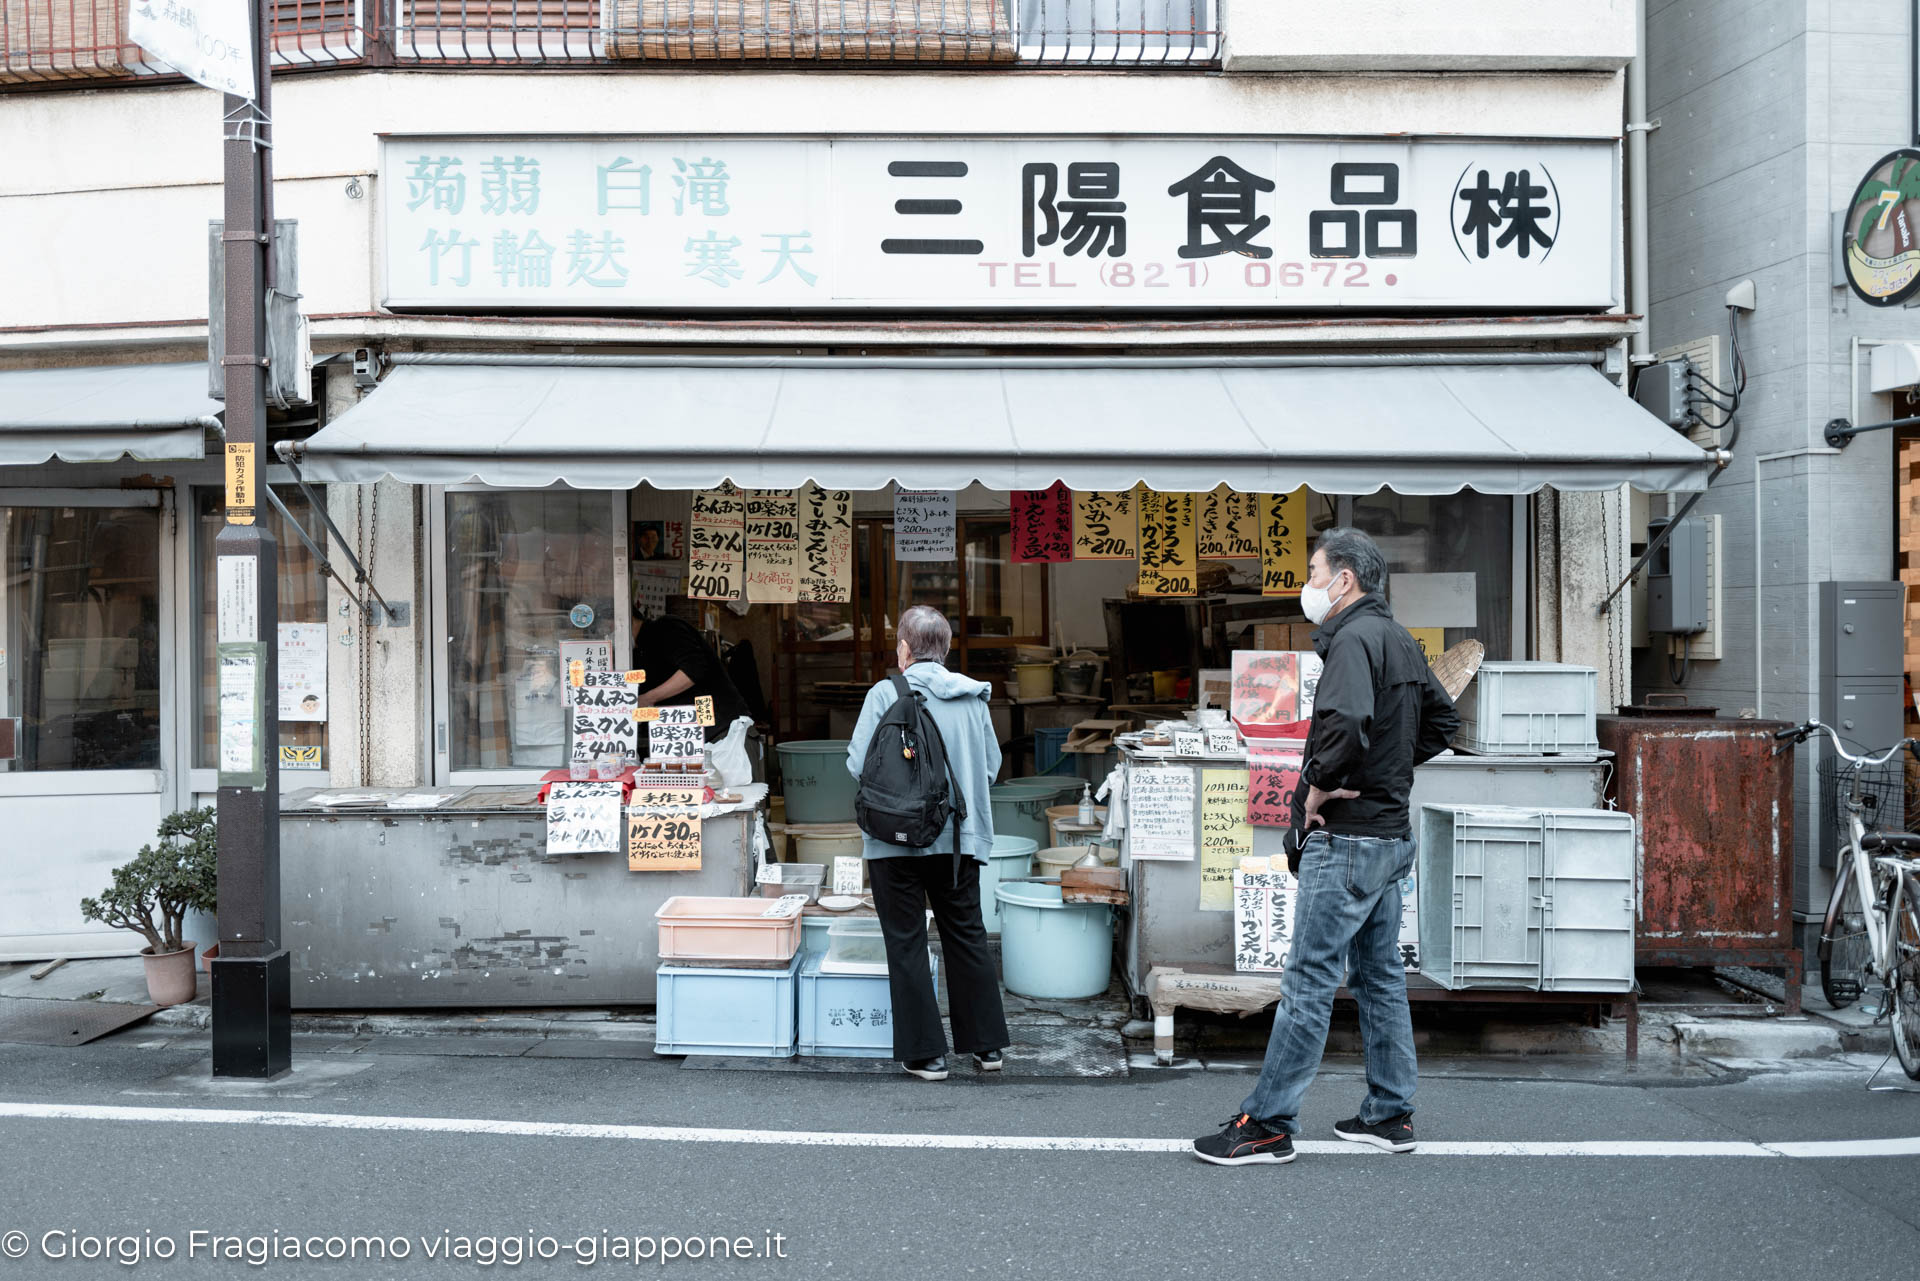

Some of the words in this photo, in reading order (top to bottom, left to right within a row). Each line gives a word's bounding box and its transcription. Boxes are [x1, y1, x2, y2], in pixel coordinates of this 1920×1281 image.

[596, 156, 731, 216] 白滝
[1877, 190, 1901, 230] 7
[1896, 209, 1911, 248] Yanaka
[684, 230, 819, 288] 寒天
[978, 262, 1077, 288] TEL
[1098, 260, 1212, 289] (821)
[235, 455, 246, 505] 防犯カメラ作動中
[692, 495, 744, 514] あんみつ
[746, 499, 797, 517] 田楽みそ
[691, 527, 742, 552] 豆かん
[805, 486, 832, 577] さしみこんにゃく
[1160, 495, 1185, 566] ところ天
[1141, 521, 1163, 568] かん天
[1199, 542, 1228, 556] 200円
[1228, 539, 1259, 554] 170円
[690, 574, 740, 598] 400円
[747, 571, 794, 585] 人気商品
[1155, 576, 1196, 594] 200円
[1264, 570, 1305, 588] 140円
[811, 584, 846, 593] 250円
[813, 593, 845, 602] 210円
[584, 672, 628, 688] 自家製
[574, 688, 638, 707] あんみつ
[658, 709, 697, 723] 手作り
[573, 715, 634, 737] 豆かん
[650, 725, 703, 742] 田楽みそ
[551, 789, 621, 800] あんみつ
[641, 792, 694, 803] 手作り
[1252, 790, 1295, 807] 120
[1242, 873, 1288, 889] 自家製
[1269, 891, 1292, 945] ところ天
[1240, 919, 1263, 954] かん天
